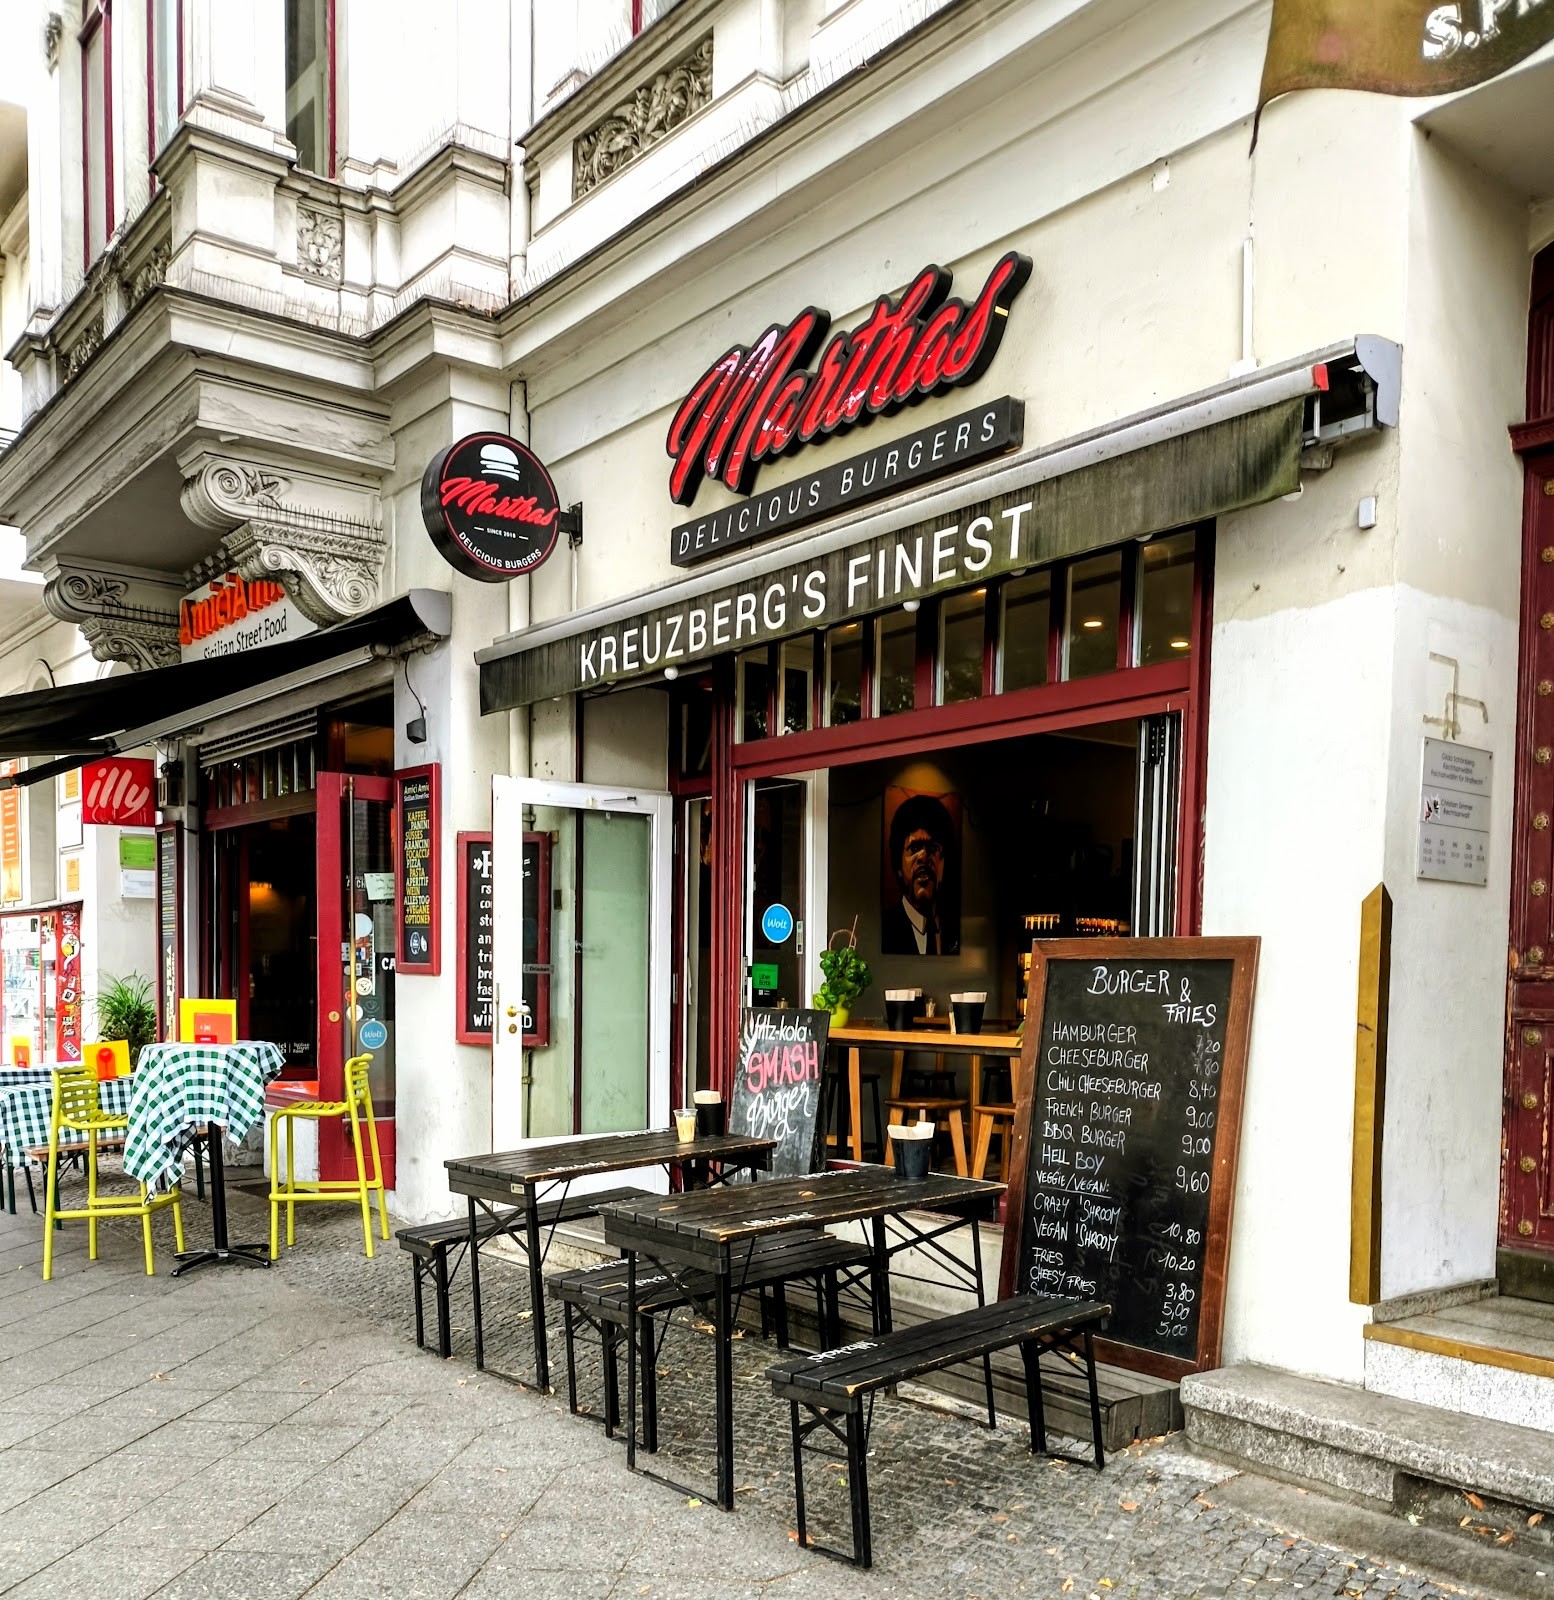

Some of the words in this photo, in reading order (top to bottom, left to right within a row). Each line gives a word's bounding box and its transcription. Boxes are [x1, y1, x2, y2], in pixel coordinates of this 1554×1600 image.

[666, 251, 1022, 505] Marthas
[678, 480, 821, 555] DELICIOUS
[840, 411, 997, 495] BURGERS
[440, 477, 558, 526] Marthas
[487, 528, 502, 536] SINCE
[459, 532, 503, 568] DELICIOUS
[505, 548, 542, 569] BURGERS
[580, 570, 827, 682] KREUZBERG'S
[848, 502, 1033, 607] FINEST
[236, 622, 262, 652] Street
[264, 608, 287, 641] Food
[87, 767, 150, 819] illy
[408, 810, 426, 822] KAFFEE
[406, 859, 421, 869] PIZZA
[410, 868, 426, 878] PASTA
[406, 877, 429, 887] APERITIF
[406, 887, 421, 896] WEIN
[767, 919, 787, 929] Wolt
[381, 957, 395, 970] CA
[1087, 966, 1169, 995] BURGER
[1179, 977, 1191, 1003] &
[1162, 1004, 1216, 1027] FRIES
[364, 1030, 383, 1038] Wolt
[1053, 1021, 1137, 1045] HAMBURGER
[747, 1041, 819, 1093] SMASH
[1047, 1046, 1149, 1074] CHEESEBURGER
[1079, 1074, 1161, 1100] CHEESEBURGER
[1188, 1080, 1216, 1101] 8,40
[747, 1081, 811, 1141] Burger
[1045, 1097, 1084, 1118] FRENCH
[1090, 1101, 1132, 1126] BURGER
[1185, 1106, 1215, 1128] 9,00
[1043, 1121, 1075, 1143] BBQ
[1081, 1125, 1125, 1154] BURGER
[1182, 1135, 1211, 1157] 9,00
[1042, 1143, 1070, 1166] HELL
[1075, 1151, 1105, 1175] BOY
[1175, 1165, 1210, 1193] 9,60
[1034, 1192, 1070, 1217] CRAZY
[1034, 1215, 1068, 1241] VEGAN
[1161, 1222, 1201, 1244] 10,80
[1158, 1252, 1196, 1271] 10,20
[1030, 1264, 1066, 1291] CHEESY
[1166, 1282, 1195, 1302] 3,80
[1162, 1302, 1190, 1320] 5,00
[1156, 1321, 1187, 1337] 5,00
